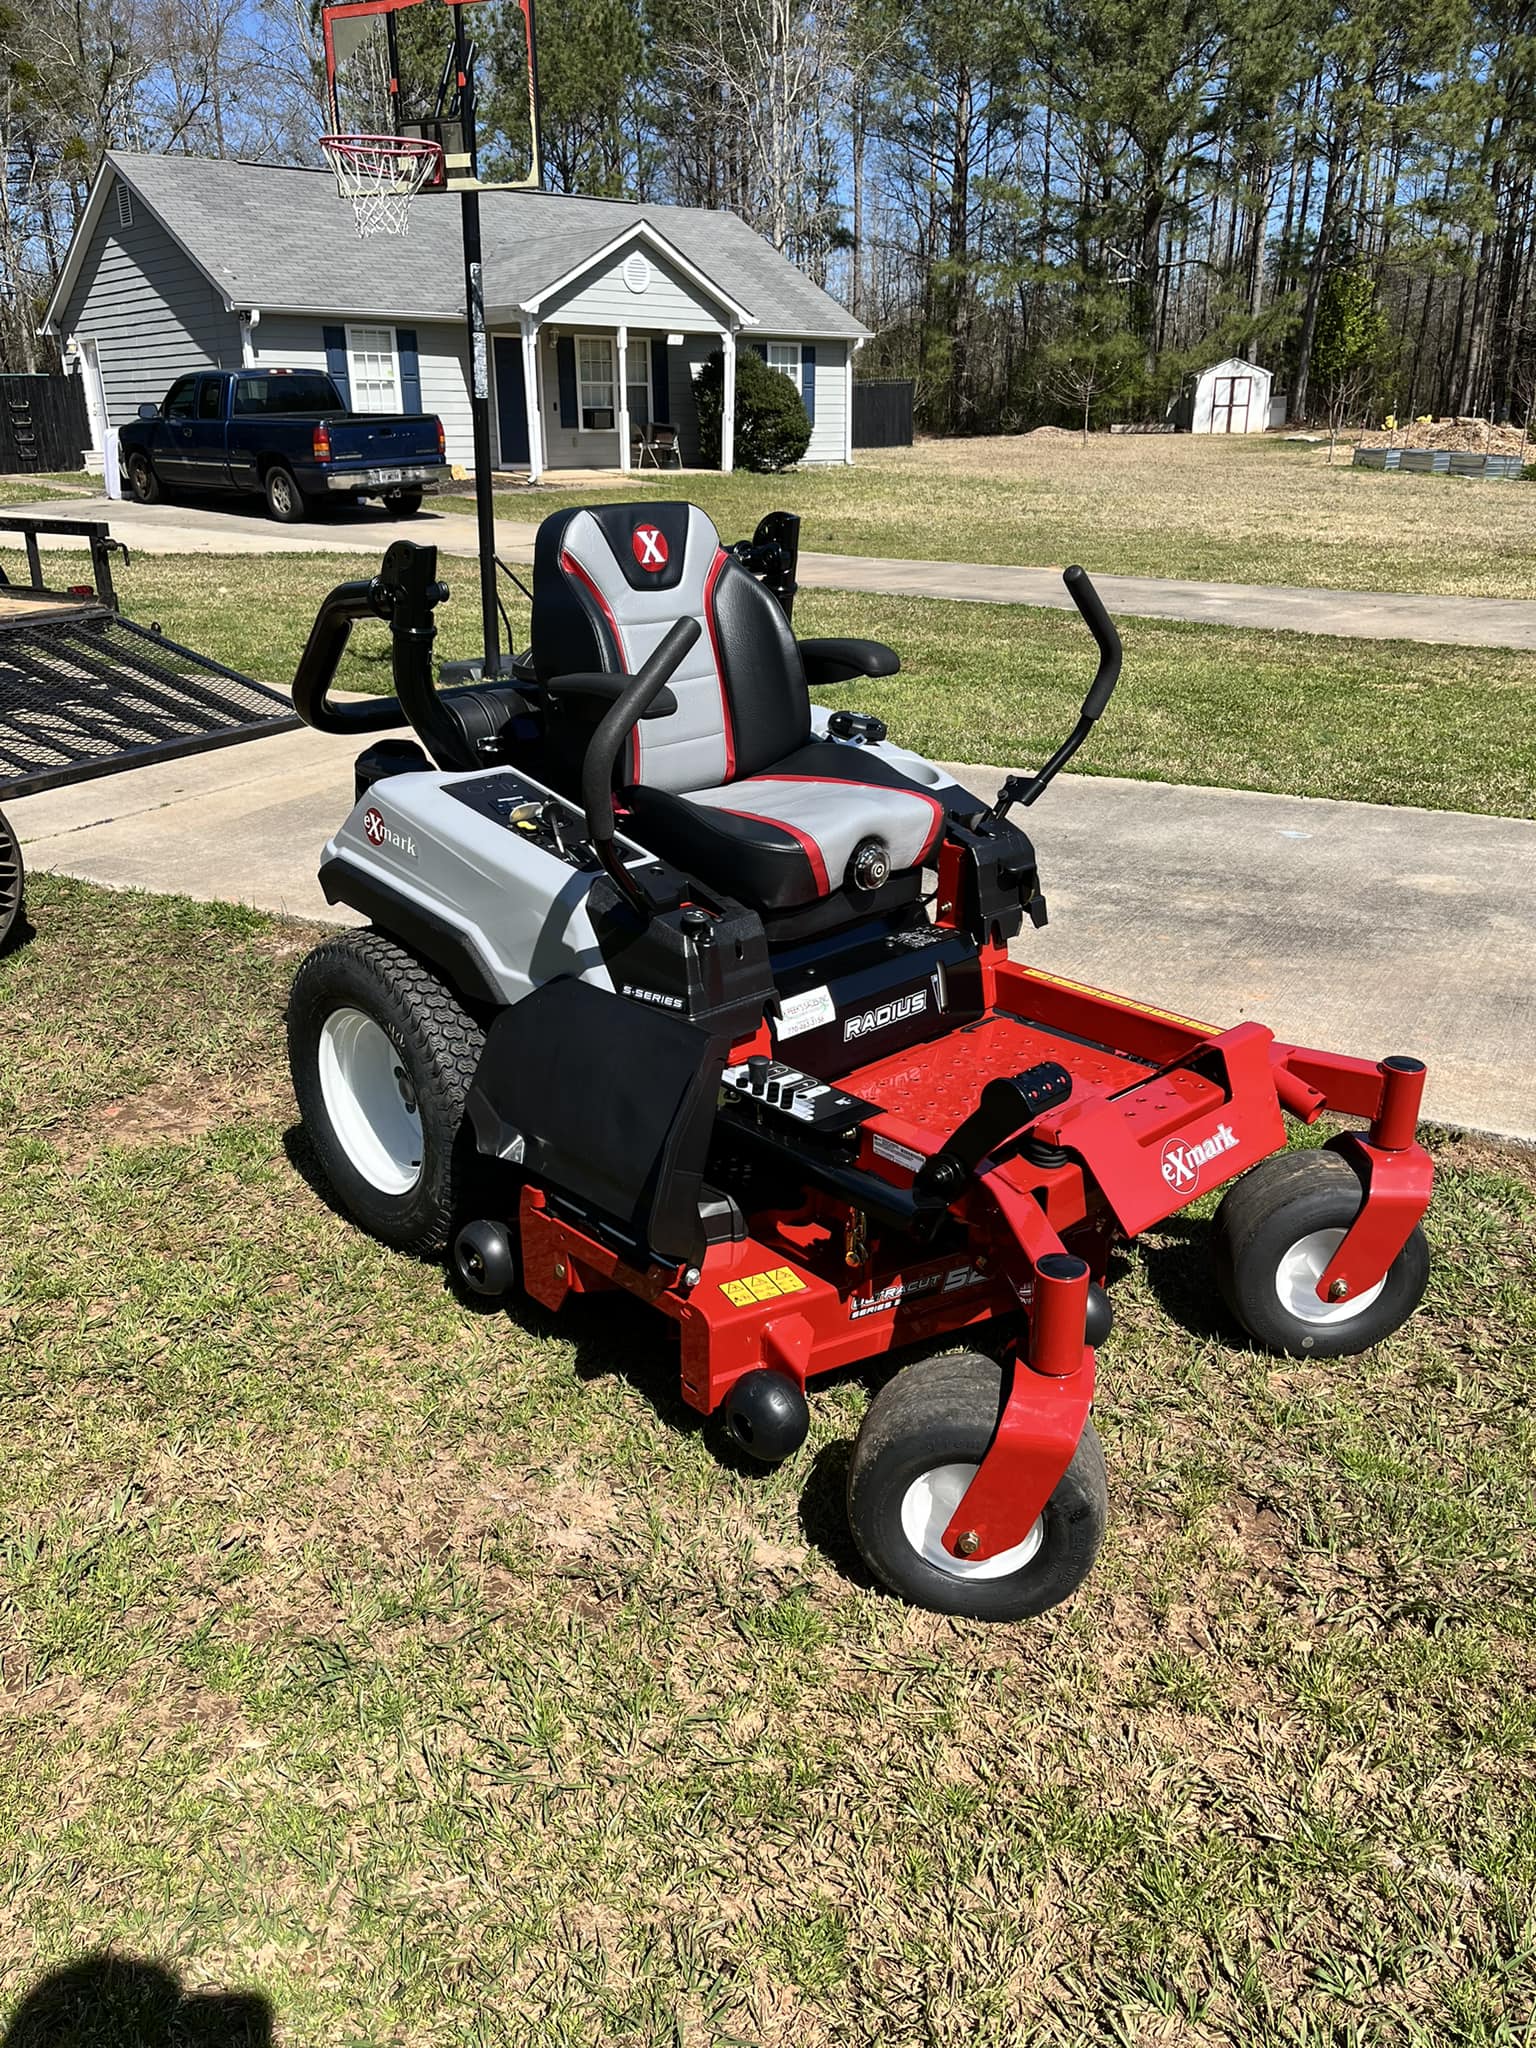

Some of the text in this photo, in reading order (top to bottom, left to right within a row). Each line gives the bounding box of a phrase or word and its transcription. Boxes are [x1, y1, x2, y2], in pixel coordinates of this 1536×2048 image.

[636, 529, 666, 564] X
[364, 811, 417, 857] eXmark
[845, 990, 927, 1041] RADIUS
[1162, 1122, 1241, 1188] eXmark
